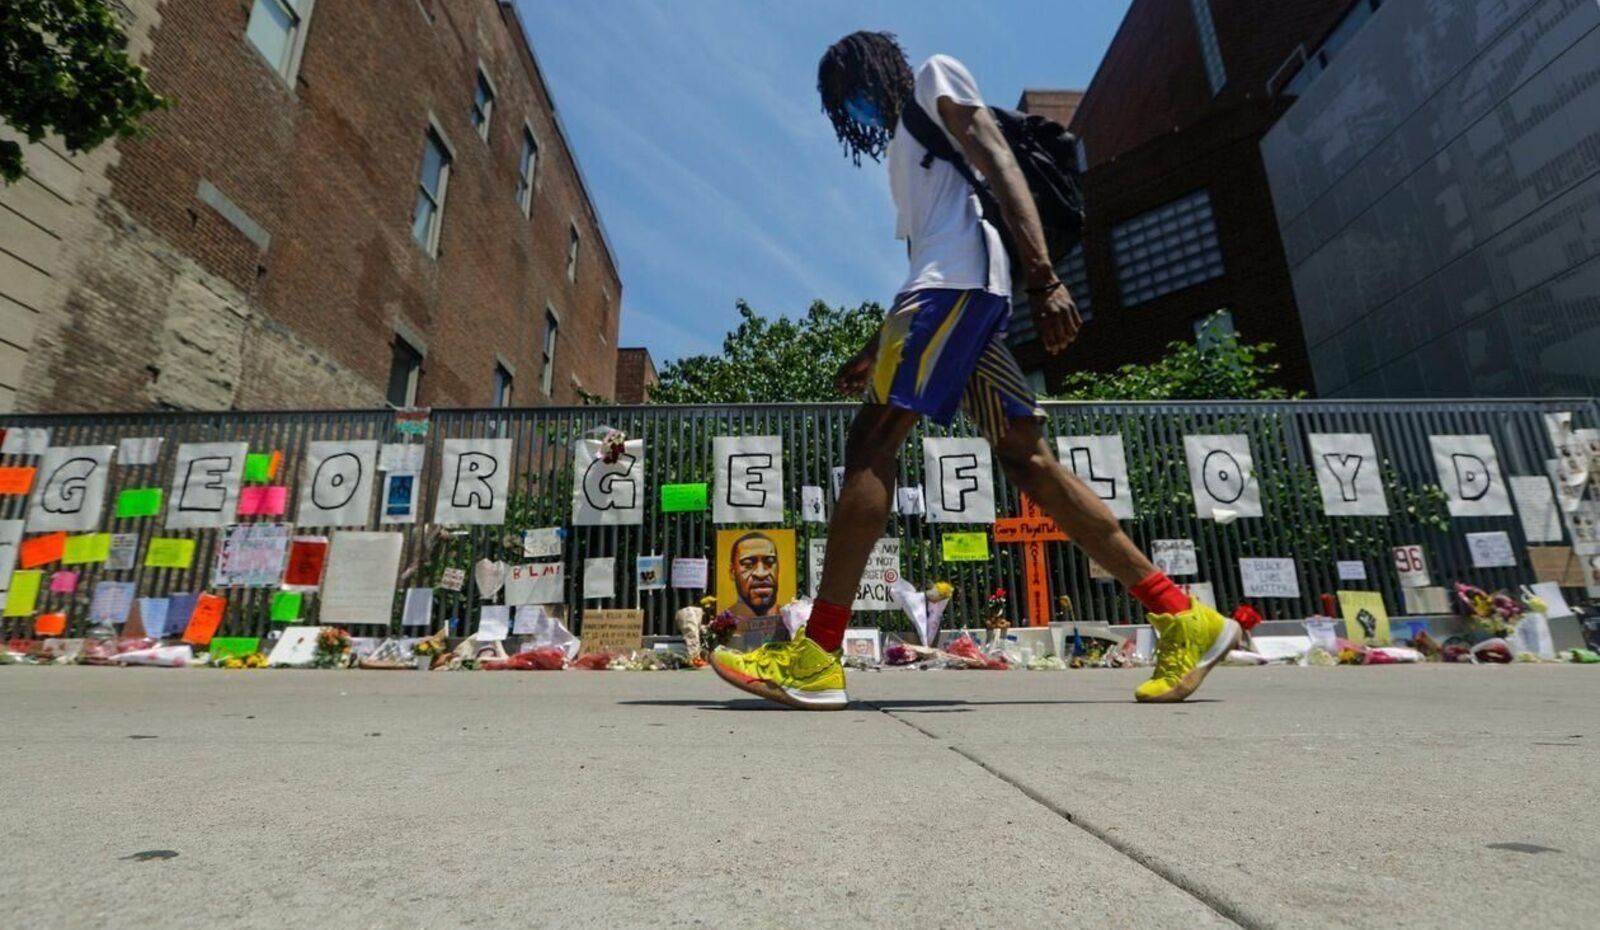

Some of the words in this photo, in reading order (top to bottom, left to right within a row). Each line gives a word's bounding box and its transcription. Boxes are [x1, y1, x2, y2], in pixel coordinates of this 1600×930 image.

[882, 543, 899, 554] MY
[876, 557, 894, 566] NOT
[1392, 547, 1424, 572] 96
